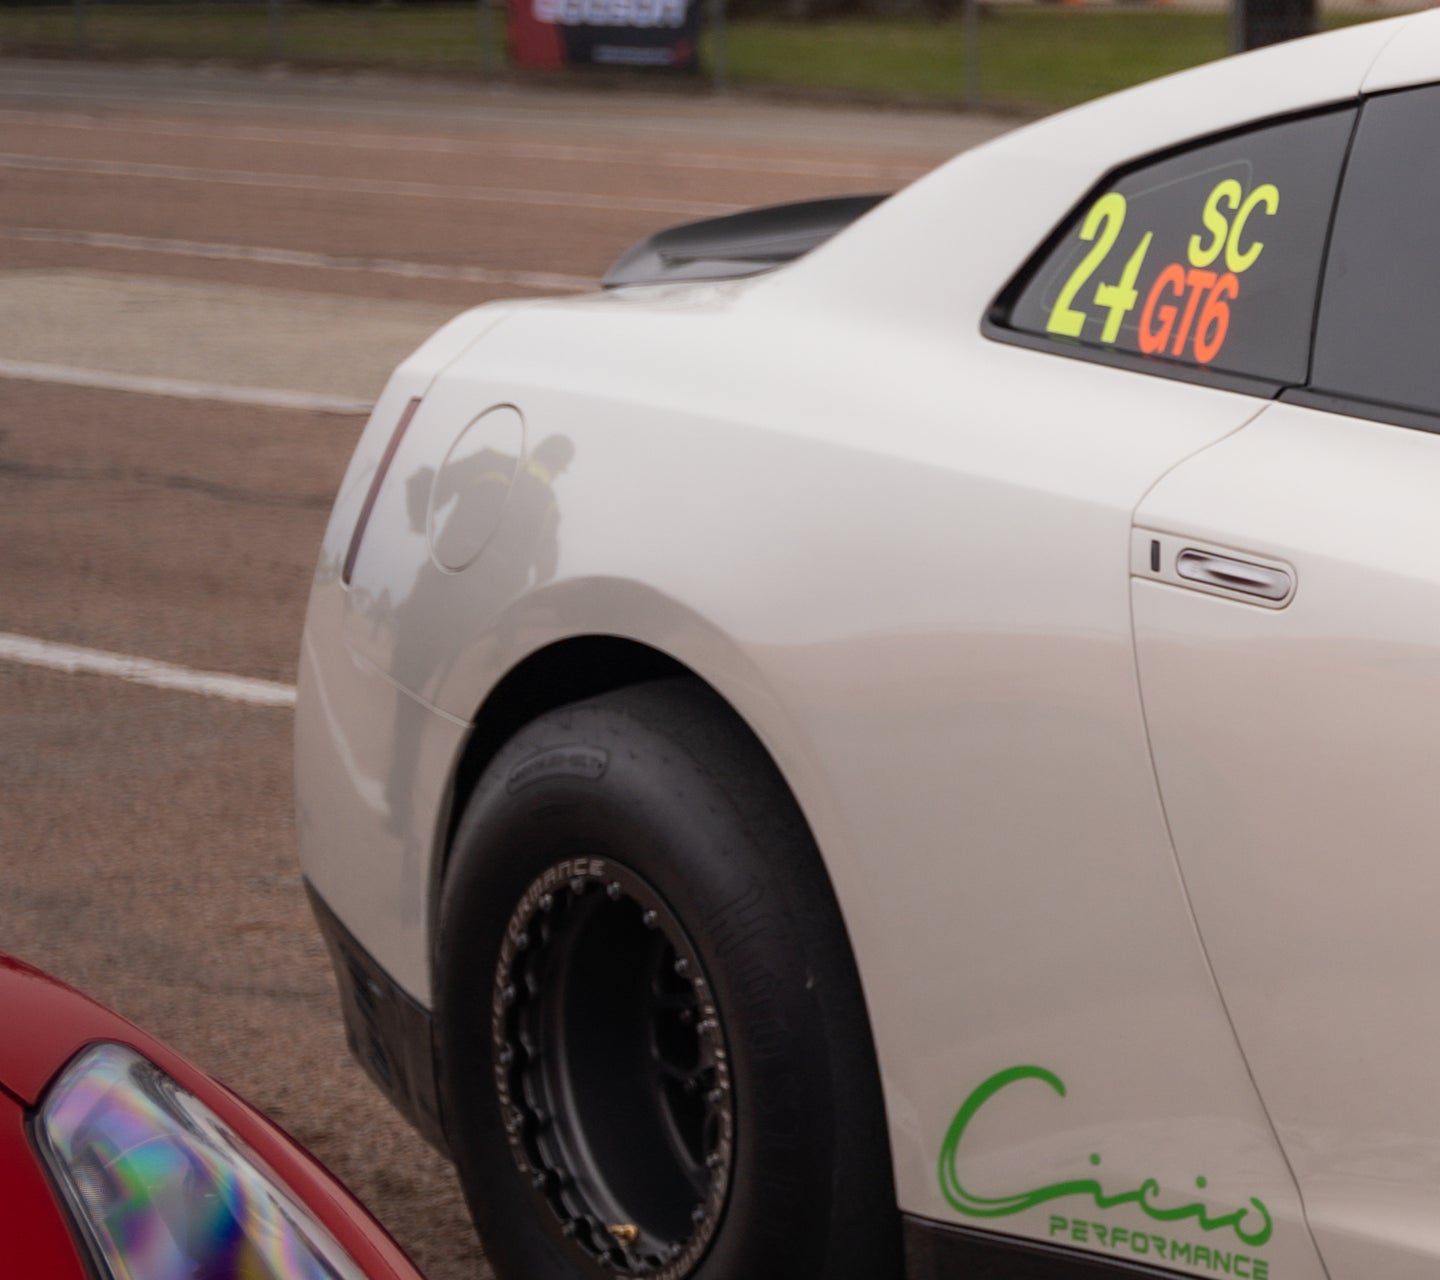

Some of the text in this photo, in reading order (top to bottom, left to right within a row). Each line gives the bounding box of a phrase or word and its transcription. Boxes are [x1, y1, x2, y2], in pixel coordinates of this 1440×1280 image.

[1187, 178, 1280, 273] SC
[1138, 262, 1240, 364] GT6
[938, 1065, 1273, 1246] Cicio
